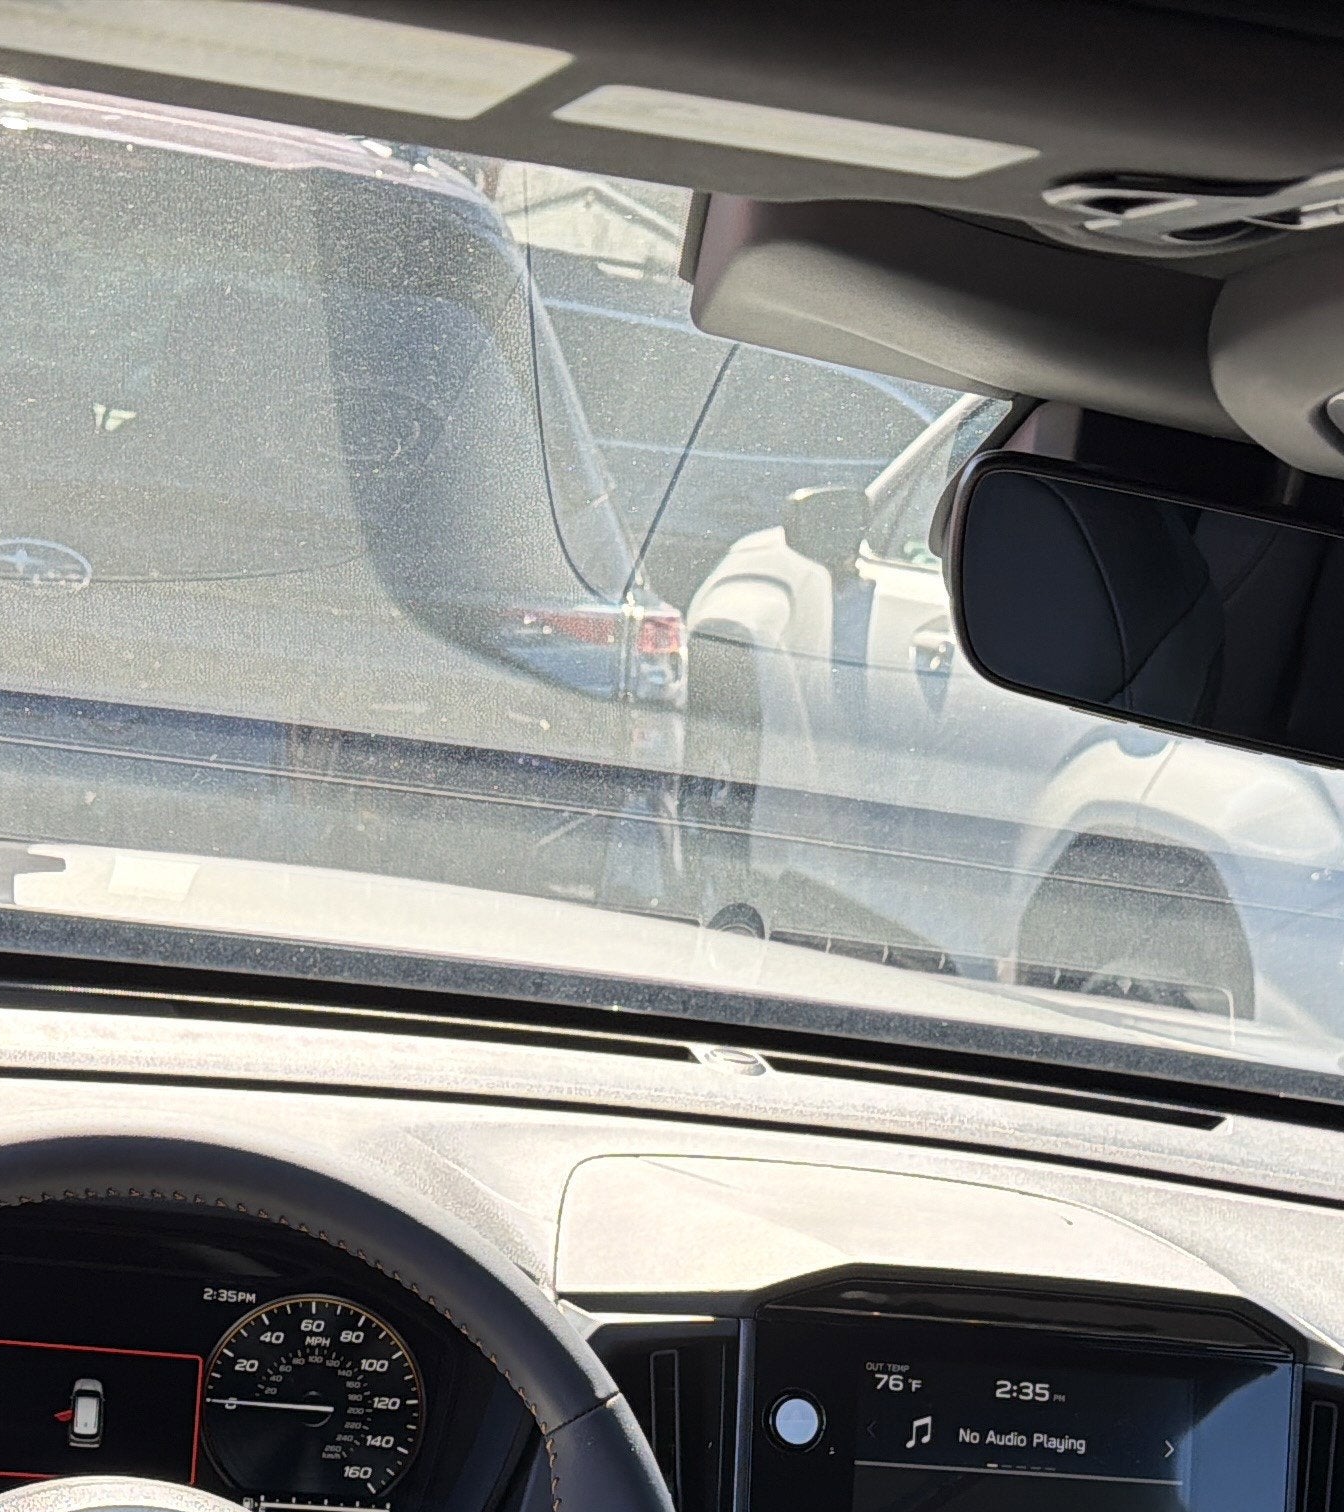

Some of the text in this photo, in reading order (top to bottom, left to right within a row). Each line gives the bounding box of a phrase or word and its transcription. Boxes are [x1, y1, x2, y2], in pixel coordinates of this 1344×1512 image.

[300, 1319, 325, 1333] 60
[259, 1331, 285, 1344] 40
[305, 1335, 330, 1347] MPH
[339, 1330, 364, 1344] 80
[234, 1358, 259, 1372] 20
[360, 1358, 389, 1372] 100
[865, 1362, 884, 1372] OUT
[874, 1373, 904, 1391] 76
[995, 1380, 1050, 1401] 2:35
[372, 1397, 400, 1410] 120
[365, 1435, 394, 1448] 140
[958, 1428, 1087, 1455] No Audio Playing
[343, 1465, 372, 1479] 160
